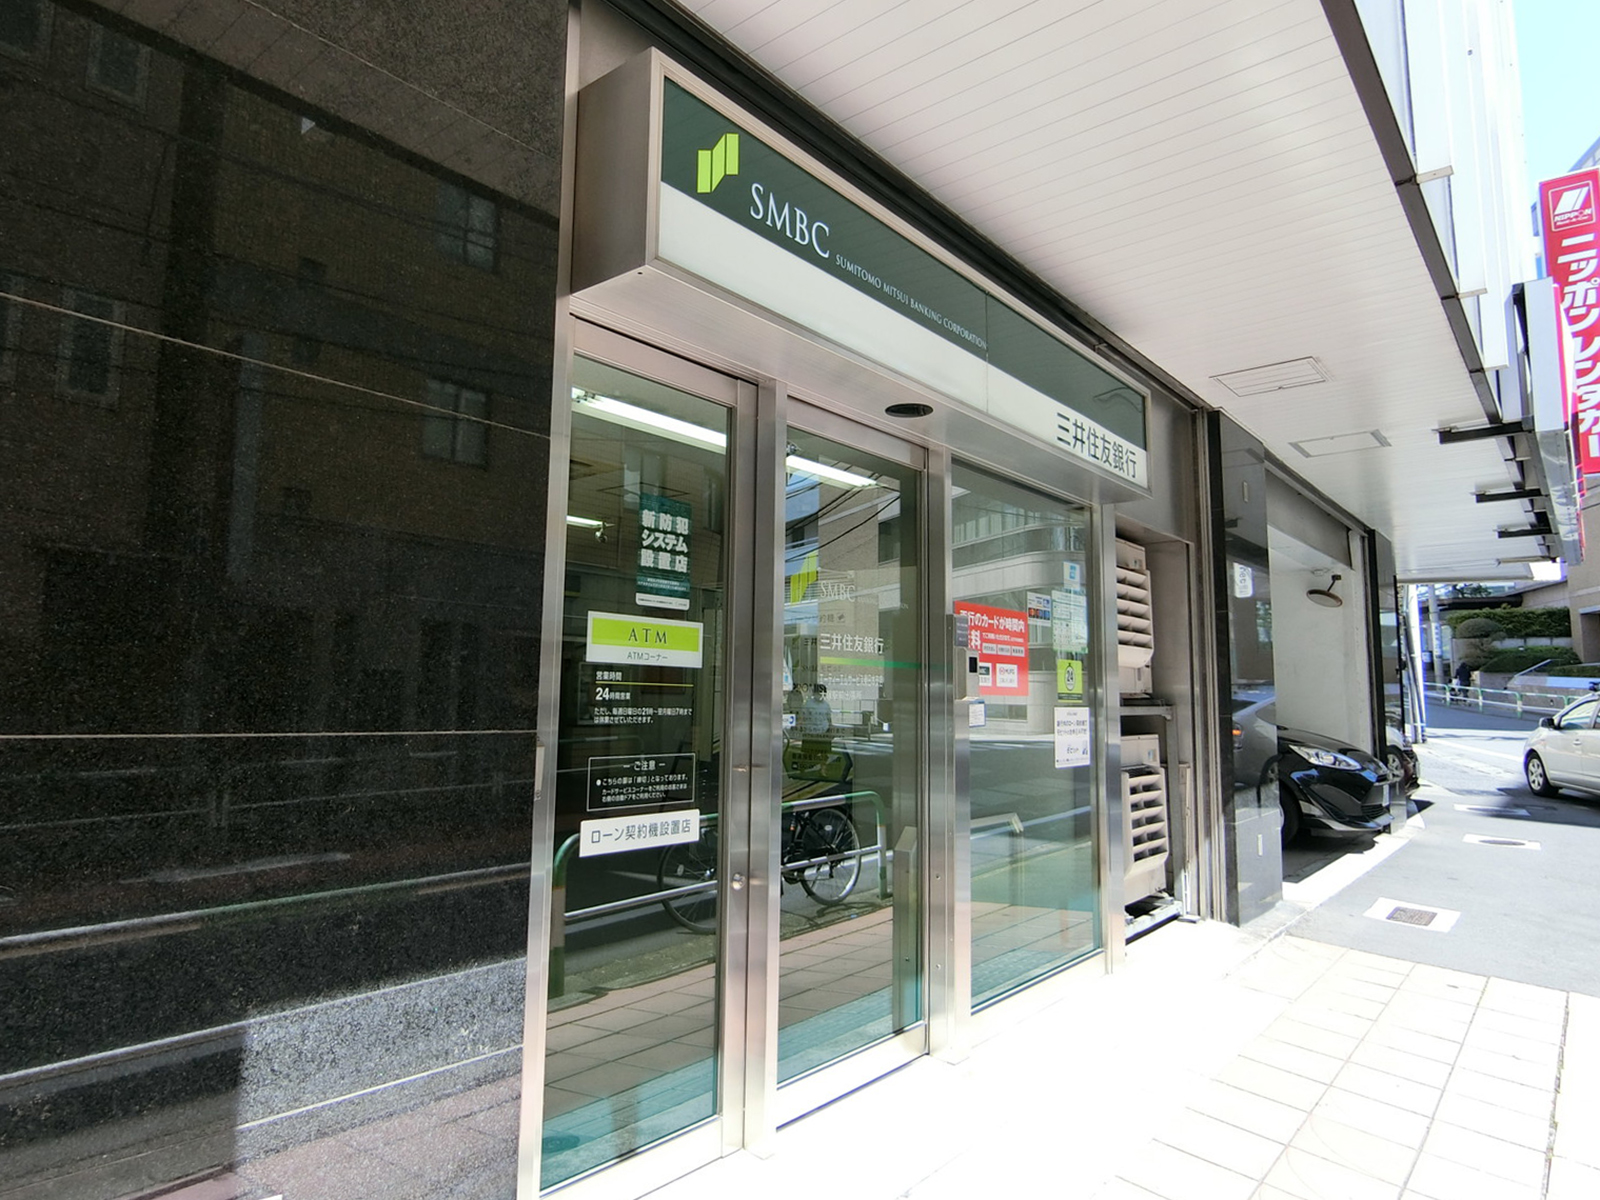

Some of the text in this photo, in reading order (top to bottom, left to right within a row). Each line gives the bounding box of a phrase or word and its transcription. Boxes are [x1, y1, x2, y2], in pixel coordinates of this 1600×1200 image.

[750, 183, 829, 258] SMBC
[835, 254, 987, 350] SUMITOMO MITSUI BANKING CORPORATION
[1057, 412, 1136, 478] 三井住友銀行
[641, 529, 688, 553] システム
[820, 581, 855, 602] SMBC
[960, 610, 1025, 633] 行のカードが時間内
[628, 628, 667, 644] ATM
[820, 633, 884, 654] 三井住友銀行
[627, 652, 668, 662] ATMコーナー
[596, 671, 622, 681] 営業時間
[634, 760, 656, 770] ご注意
[591, 819, 691, 843] ローン契約機設置店
